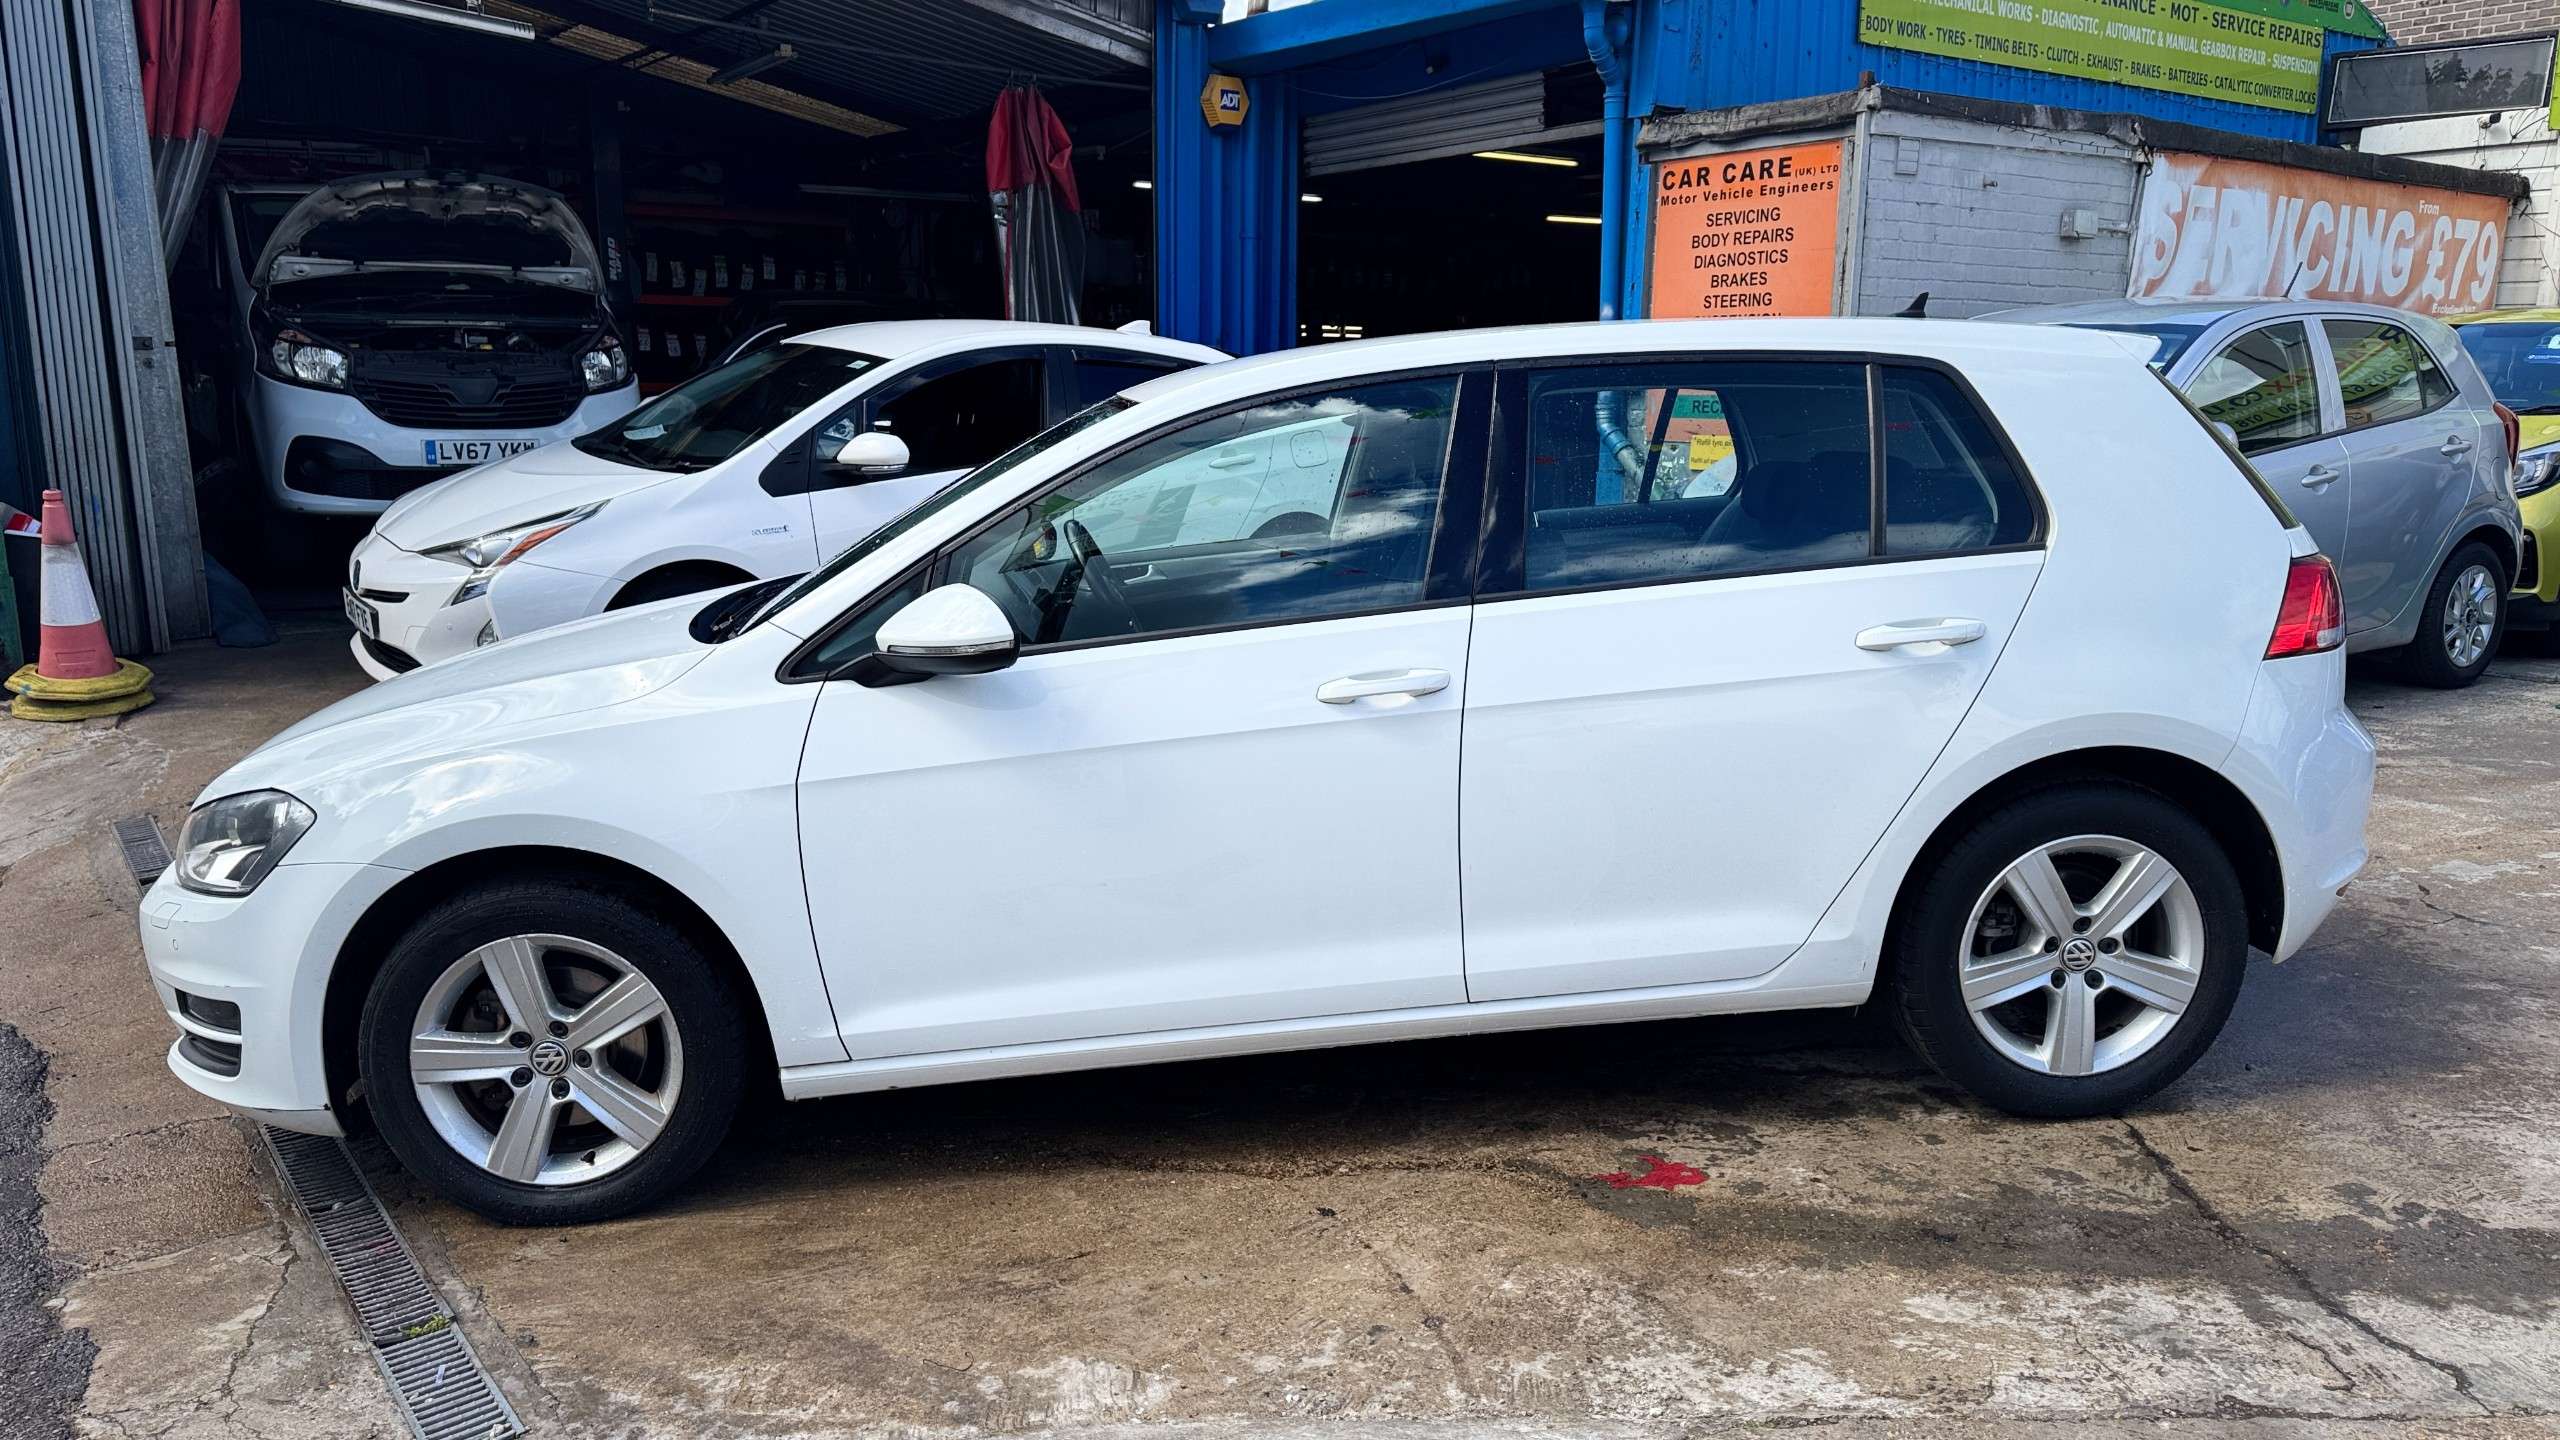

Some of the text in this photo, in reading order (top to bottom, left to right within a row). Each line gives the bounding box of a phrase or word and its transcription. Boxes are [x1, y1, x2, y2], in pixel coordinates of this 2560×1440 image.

[2170, 3, 2199, 23] MOT
[2211, 11, 2265, 38] SERVICE
[2269, 23, 2322, 49] REPAIRS
[1929, 0, 1995, 15] CHANICAL
[1998, 2, 2033, 23] WORKS
[2041, 8, 2099, 35] DIAGNOSTIC
[2105, 21, 2156, 45] AUTOMATIC
[2156, 31, 2164, 46] &
[2165, 32, 2199, 54] MANUAL
[2201, 39, 2237, 64] GEARBOX
[2238, 47, 2266, 66] REPAIR
[2272, 53, 2319, 75] SUSPENSION
[1865, 14, 1894, 34] BODY
[1896, 19, 1927, 40] WORK
[1936, 27, 1966, 47] TYRES
[1974, 33, 2009, 54] TIMING
[2011, 39, 2039, 58] BELTS
[2046, 46, 2079, 65] CLUTCH
[2086, 53, 2123, 73] EXHAUST
[2130, 61, 2161, 80] BRAKES
[2168, 67, 2208, 87] BATTERIES
[2214, 75, 2253, 95] CATALYTIC
[2254, 82, 2294, 102] CONVERTER
[2294, 91, 2316, 105] LOCKS
[1220, 92, 1240, 108] ADT
[1662, 156, 1839, 191] CAR CARE (UK) LTD
[1660, 179, 1834, 206] Motor Vehicle Engineers
[1706, 207, 1781, 227] SERVICING
[2418, 199, 2440, 216] From
[1691, 227, 1794, 249] BODY REPAIRS
[2134, 180, 2415, 299] SERVICING
[1694, 249, 1789, 269] DIAGNOSTICS
[2422, 215, 2498, 303] £79
[1710, 271, 1768, 288] BRAKES
[1703, 292, 1772, 309] STEERING
[1692, 400, 1723, 414] REC
[439, 442, 491, 460] LV67
